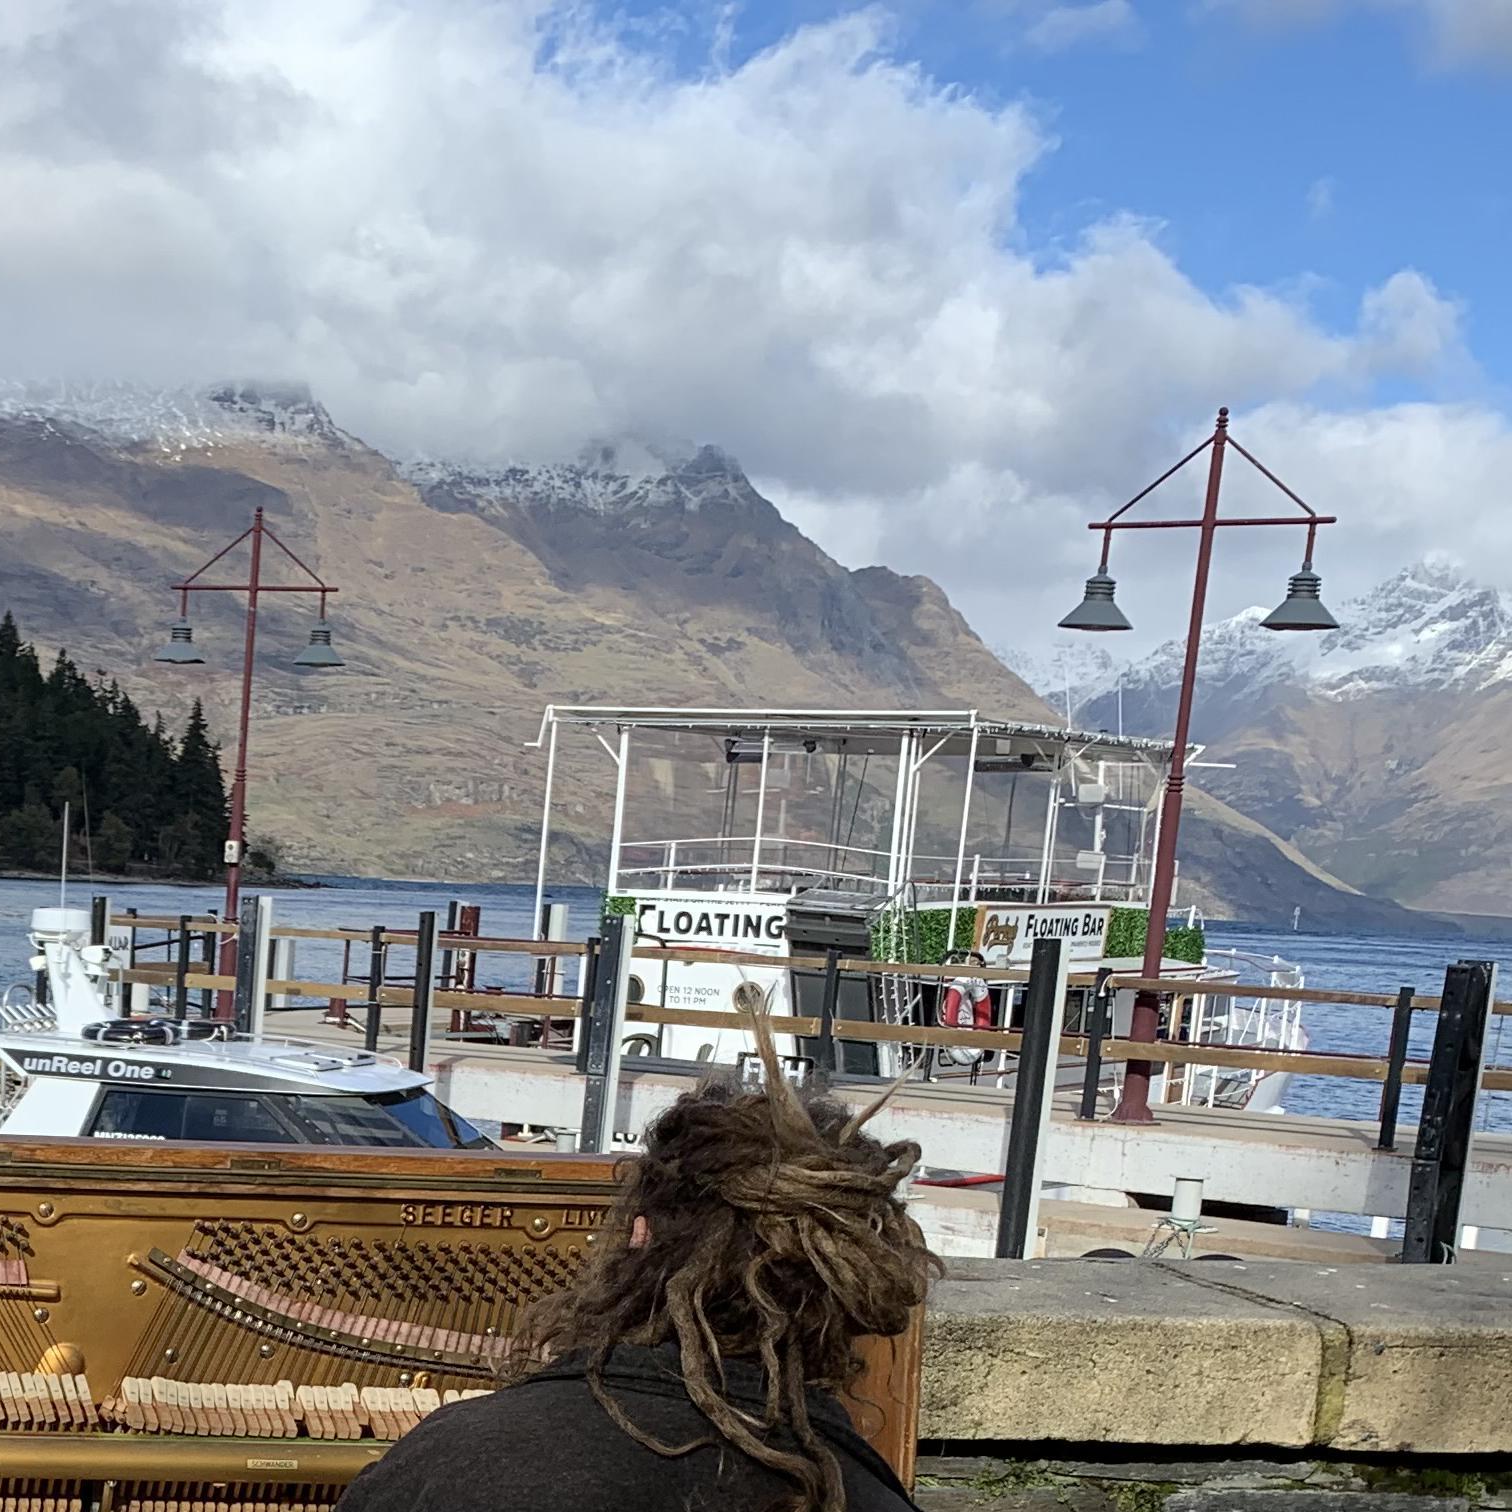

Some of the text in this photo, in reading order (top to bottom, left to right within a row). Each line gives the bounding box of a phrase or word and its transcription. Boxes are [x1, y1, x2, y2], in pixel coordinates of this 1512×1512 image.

[1025, 914, 1079, 937] FLOATING
[1081, 913, 1104, 936] BAR
[669, 995, 680, 1003] TO
[694, 997, 706, 1005] PM
[683, 986, 692, 994] 12
[694, 987, 720, 996] NOON
[22, 1056, 102, 1076] unReel
[107, 1060, 155, 1080] One
[401, 1204, 514, 1227] SEEGER
